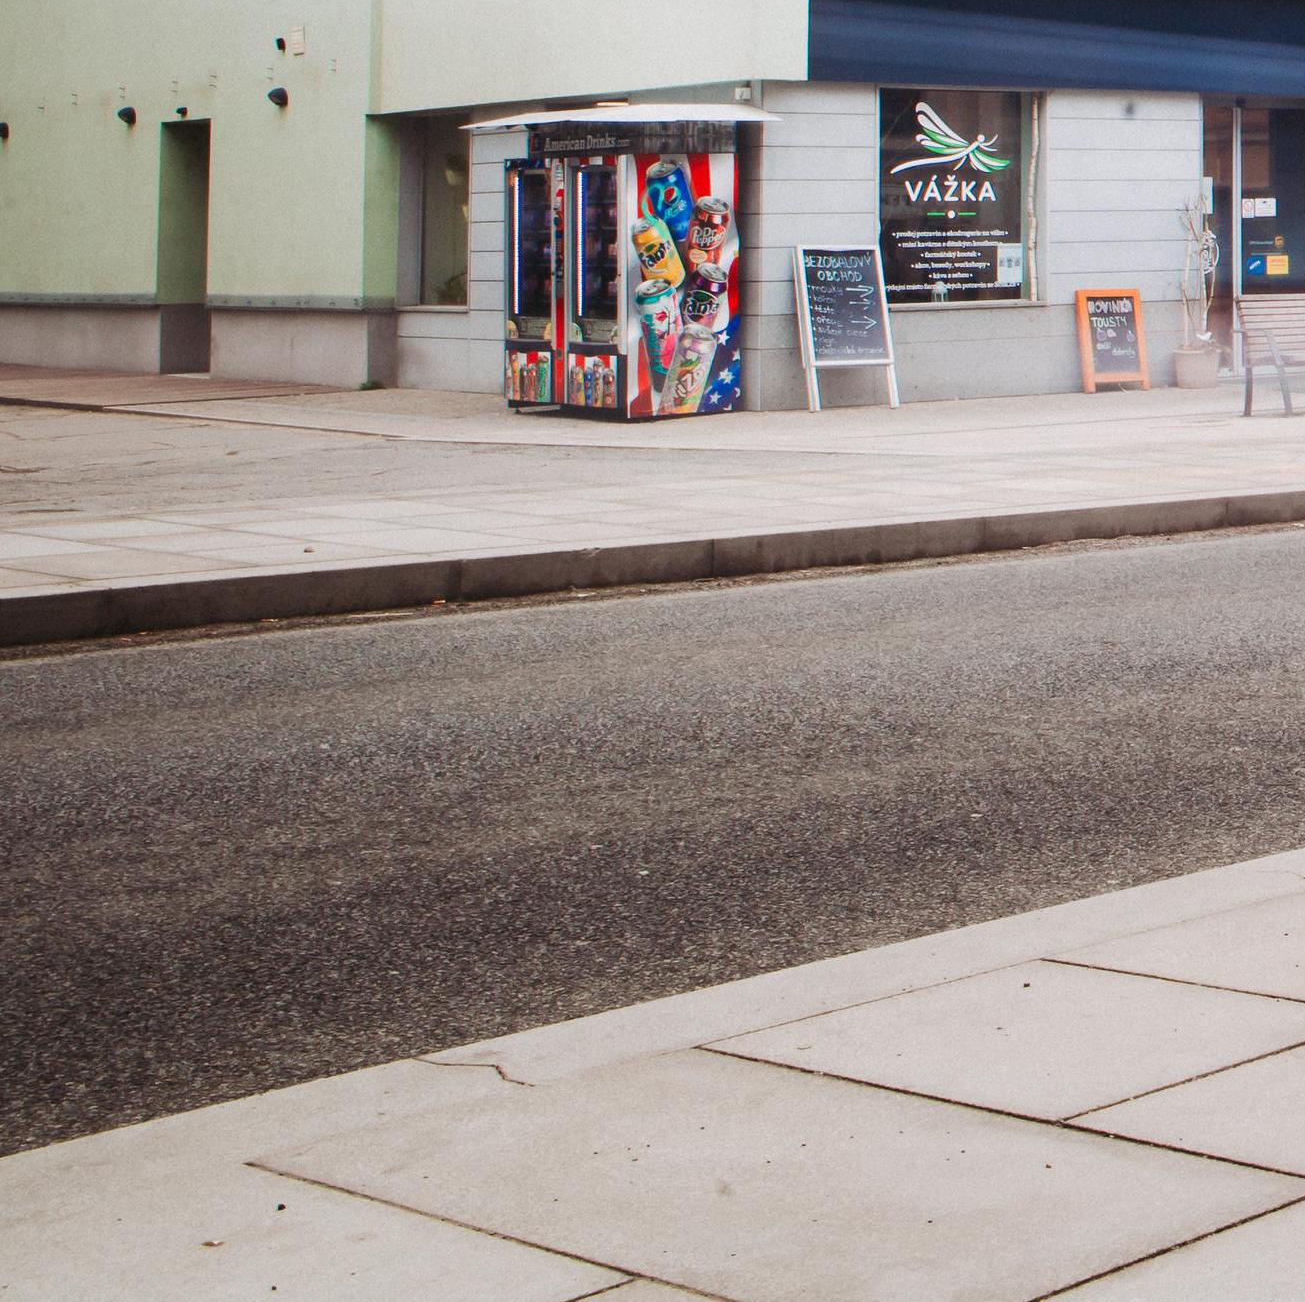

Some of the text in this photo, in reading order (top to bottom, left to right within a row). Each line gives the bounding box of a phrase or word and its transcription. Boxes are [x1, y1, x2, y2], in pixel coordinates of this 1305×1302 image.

[904, 174, 997, 202] VÁŽKA
[804, 252, 872, 269] BEZOBALOVÝ
[817, 271, 863, 282] OBCHOD
[1090, 316, 1127, 328] TOUSTY
